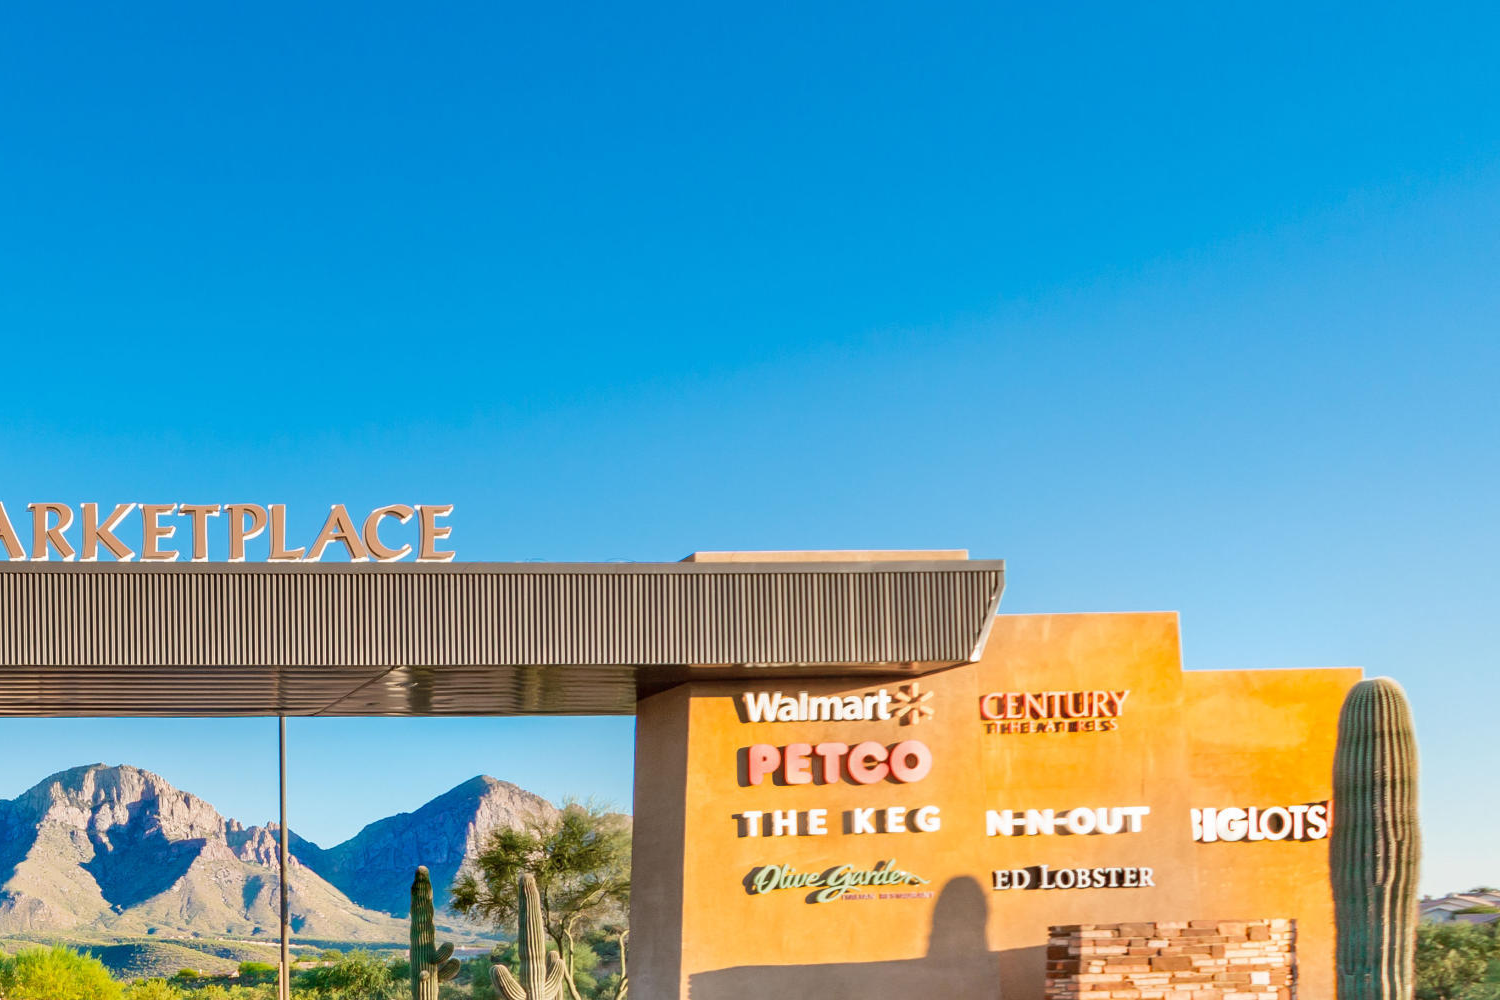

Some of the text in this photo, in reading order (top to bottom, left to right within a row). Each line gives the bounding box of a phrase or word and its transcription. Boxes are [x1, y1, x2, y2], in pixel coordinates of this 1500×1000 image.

[744, 688, 893, 723] Walmart
[981, 689, 1131, 720] CENTURY
[748, 739, 933, 786] PETCO
[742, 805, 941, 837] THE KEG
[753, 858, 930, 904] Olive Garden
[994, 864, 1156, 890] ED LOBSTER
